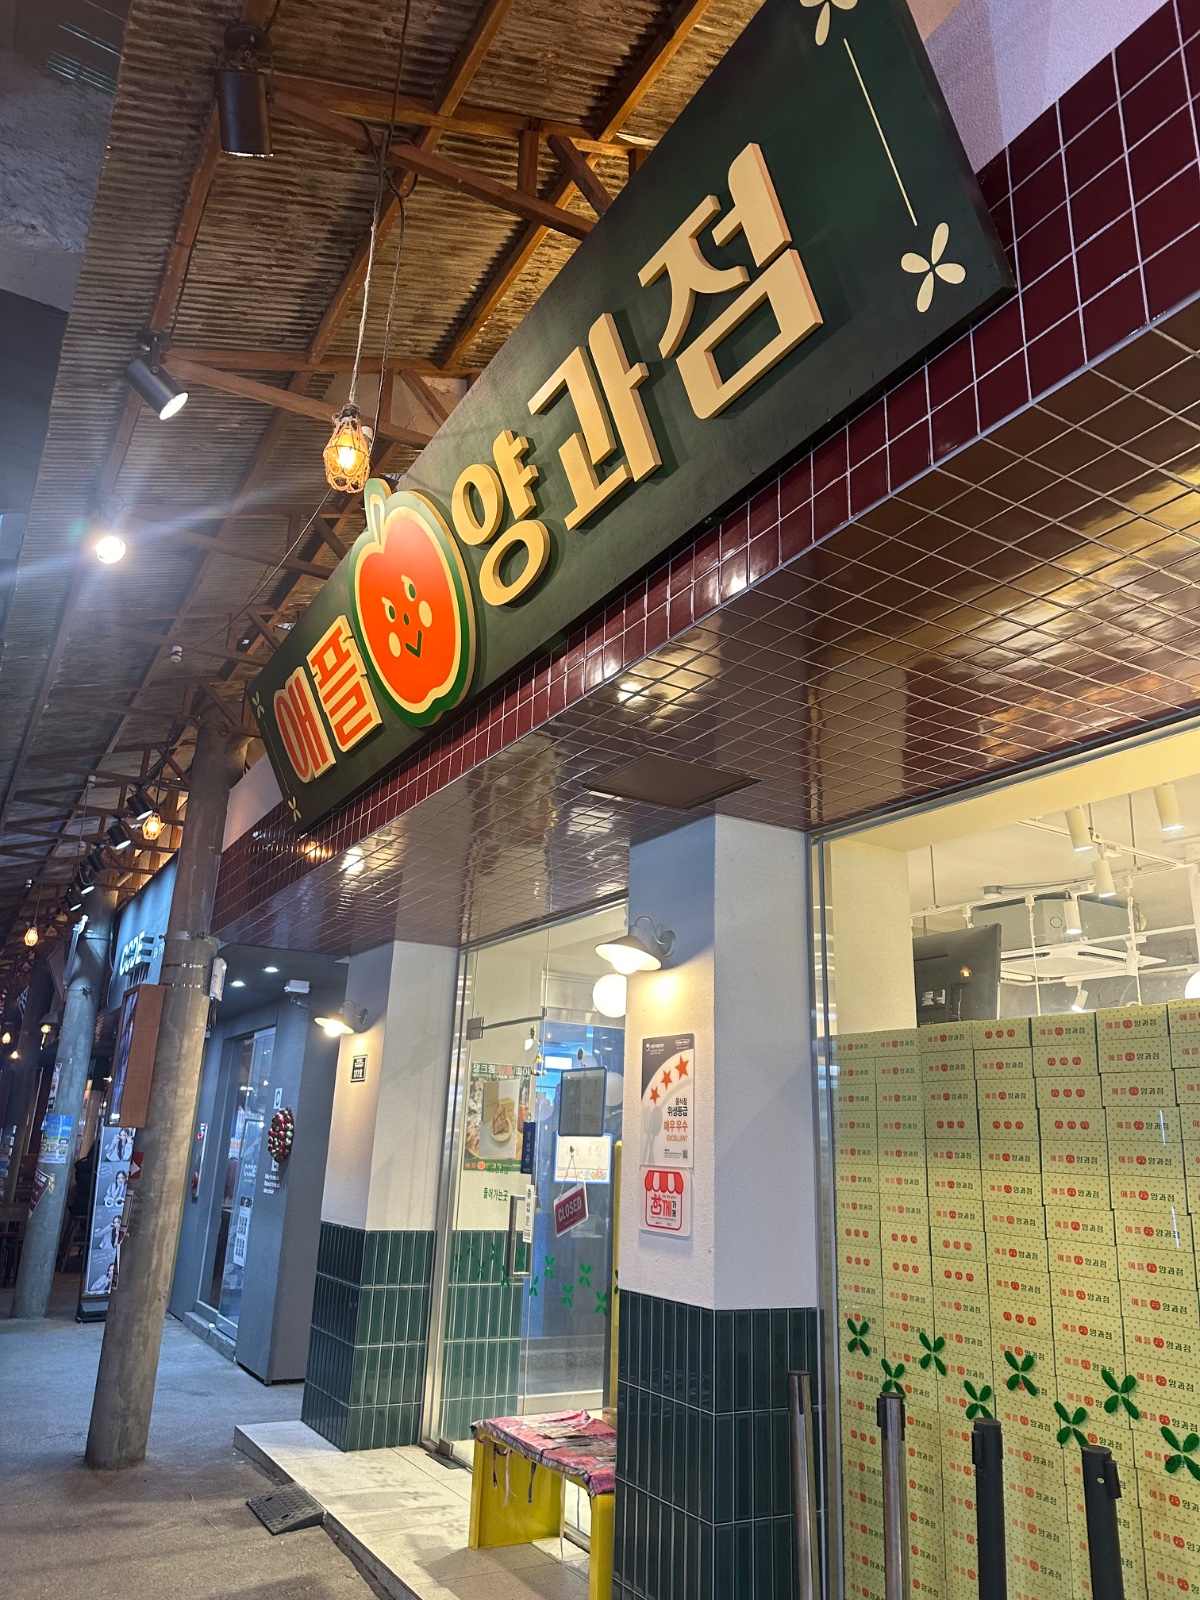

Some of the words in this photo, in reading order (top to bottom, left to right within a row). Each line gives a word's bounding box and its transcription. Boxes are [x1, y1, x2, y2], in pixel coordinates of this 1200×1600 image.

[274, 615, 382, 783] 애플
[452, 142, 824, 606] 양과점
[1106, 1021, 1120, 1029] 애플
[1134, 1018, 1156, 1027] 양과점
[1065, 1026, 1085, 1034] 양과점
[1108, 1053, 1123, 1061] 애플
[1136, 1051, 1159, 1060] 양과점
[1112, 1087, 1127, 1095] 애플
[1141, 1087, 1163, 1095] 양과점
[667, 1106, 688, 1117] 위생등급
[1116, 1121, 1131, 1129] 애플
[1076, 1156, 1097, 1164] 양과점
[1119, 1156, 1134, 1164] 애플
[1148, 1157, 1171, 1165] 양과점
[1013, 1186, 1032, 1194] 양과점
[1078, 1189, 1099, 1198] 양과점
[1121, 1190, 1136, 1199] 애플
[1150, 1192, 1174, 1202] 양과점
[557, 1196, 582, 1222] CLOSED
[1016, 1217, 1035, 1225] 양과점
[1081, 1223, 1103, 1232] 양과점
[1126, 1225, 1141, 1234] 애플
[1019, 1251, 1038, 1260] 양과점
[1084, 1257, 1106, 1267] 양과점
[1128, 1260, 1144, 1271] 애플
[1158, 1265, 1183, 1276] 양과점
[1020, 1283, 1039, 1293] 양과점
[1087, 1292, 1109, 1303] 양과점
[1132, 1297, 1147, 1308] 애플
[1162, 1302, 1187, 1315] 양과점
[1089, 1328, 1111, 1339] 양과점
[1135, 1334, 1151, 1345] 애플
[1166, 1340, 1191, 1353] 양과점
[1137, 1371, 1153, 1383] 애플
[1168, 1378, 1194, 1392] 양과점
[1030, 1419, 1050, 1431] 양과점
[1140, 1409, 1156, 1421] 애플
[1172, 1417, 1197, 1432] 양과점
[1145, 1448, 1161, 1461] 애플
[1033, 1454, 1053, 1467] 양과점
[1036, 1491, 1057, 1504] 양과점
[1150, 1489, 1167, 1502] 애플
[1182, 1499, 1200, 1513] 양과
[1038, 1528, 1059, 1541] 양과점
[1153, 1529, 1170, 1543] 애플
[1040, 1564, 1062, 1578] 양과점
[1157, 1570, 1174, 1585] 애플
